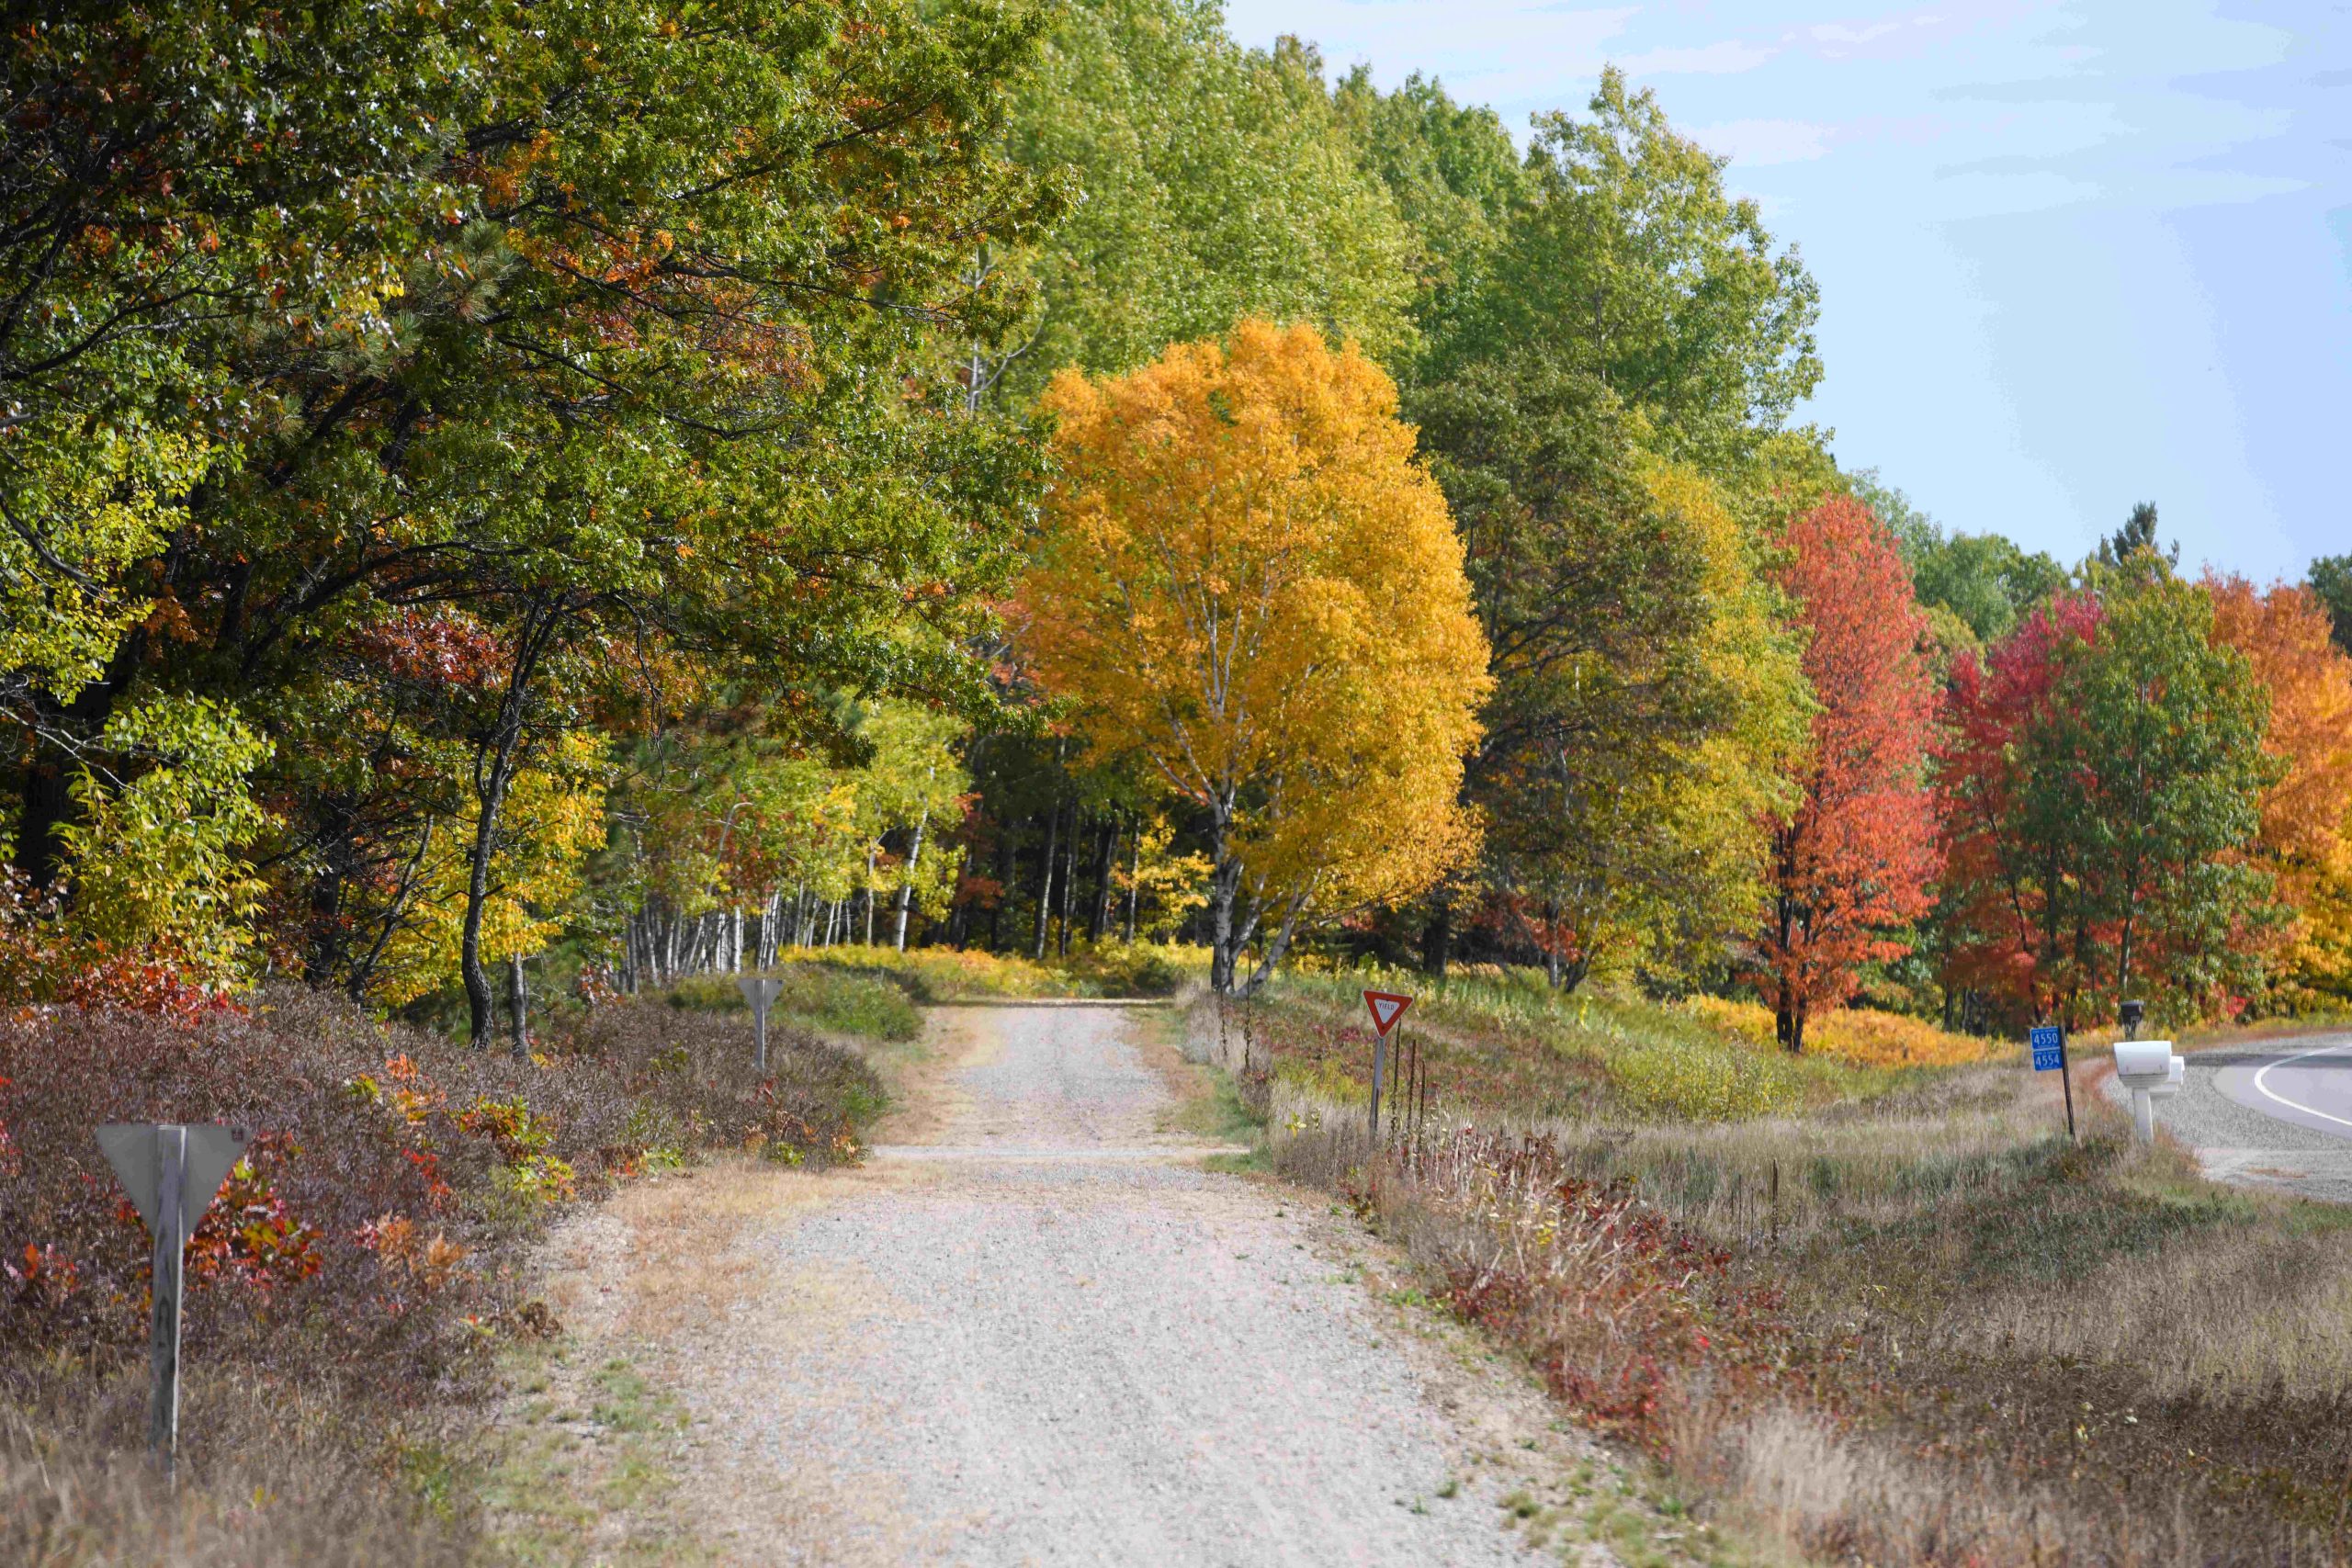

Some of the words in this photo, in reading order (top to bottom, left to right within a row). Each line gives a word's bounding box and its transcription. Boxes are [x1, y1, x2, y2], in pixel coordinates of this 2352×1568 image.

[1379, 1002, 1395, 1010] YIELD
[2034, 1032, 2058, 1044] 4550
[2036, 1054, 2060, 1066] 4554
